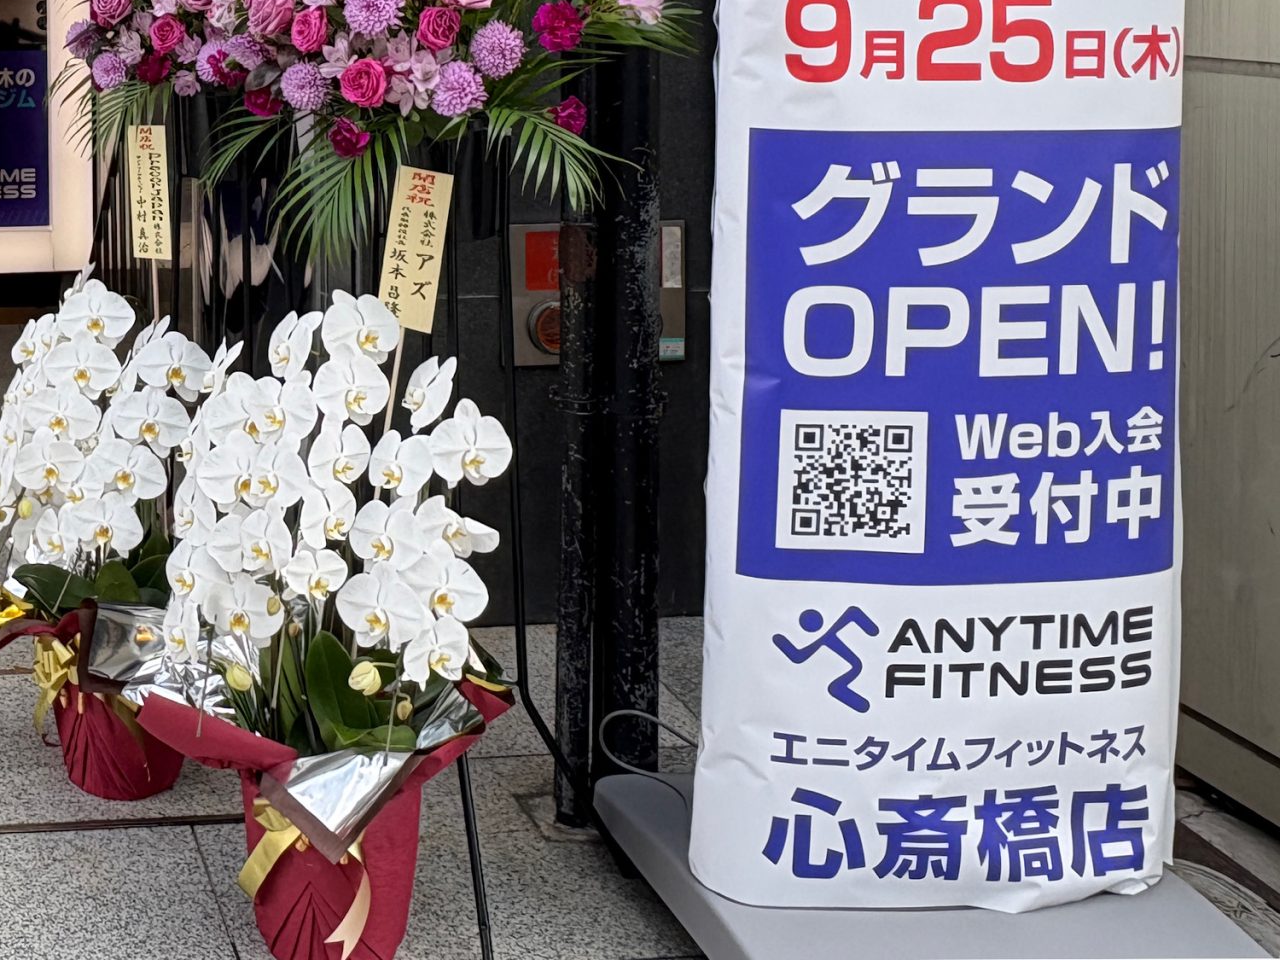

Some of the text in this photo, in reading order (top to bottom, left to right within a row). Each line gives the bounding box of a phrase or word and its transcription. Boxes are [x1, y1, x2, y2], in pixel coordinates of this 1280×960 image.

[791, 159, 1171, 267] グランド
[783, 280, 1166, 378] OPEN!
[954, 406, 1164, 461] Web入会
[950, 465, 1162, 547] 受付中
[887, 605, 1154, 654] ANYTIME
[884, 650, 1153, 700] FITNESS
[770, 725, 1147, 772] エニタイムフィットネス
[762, 783, 1150, 883] 心斎橋店
